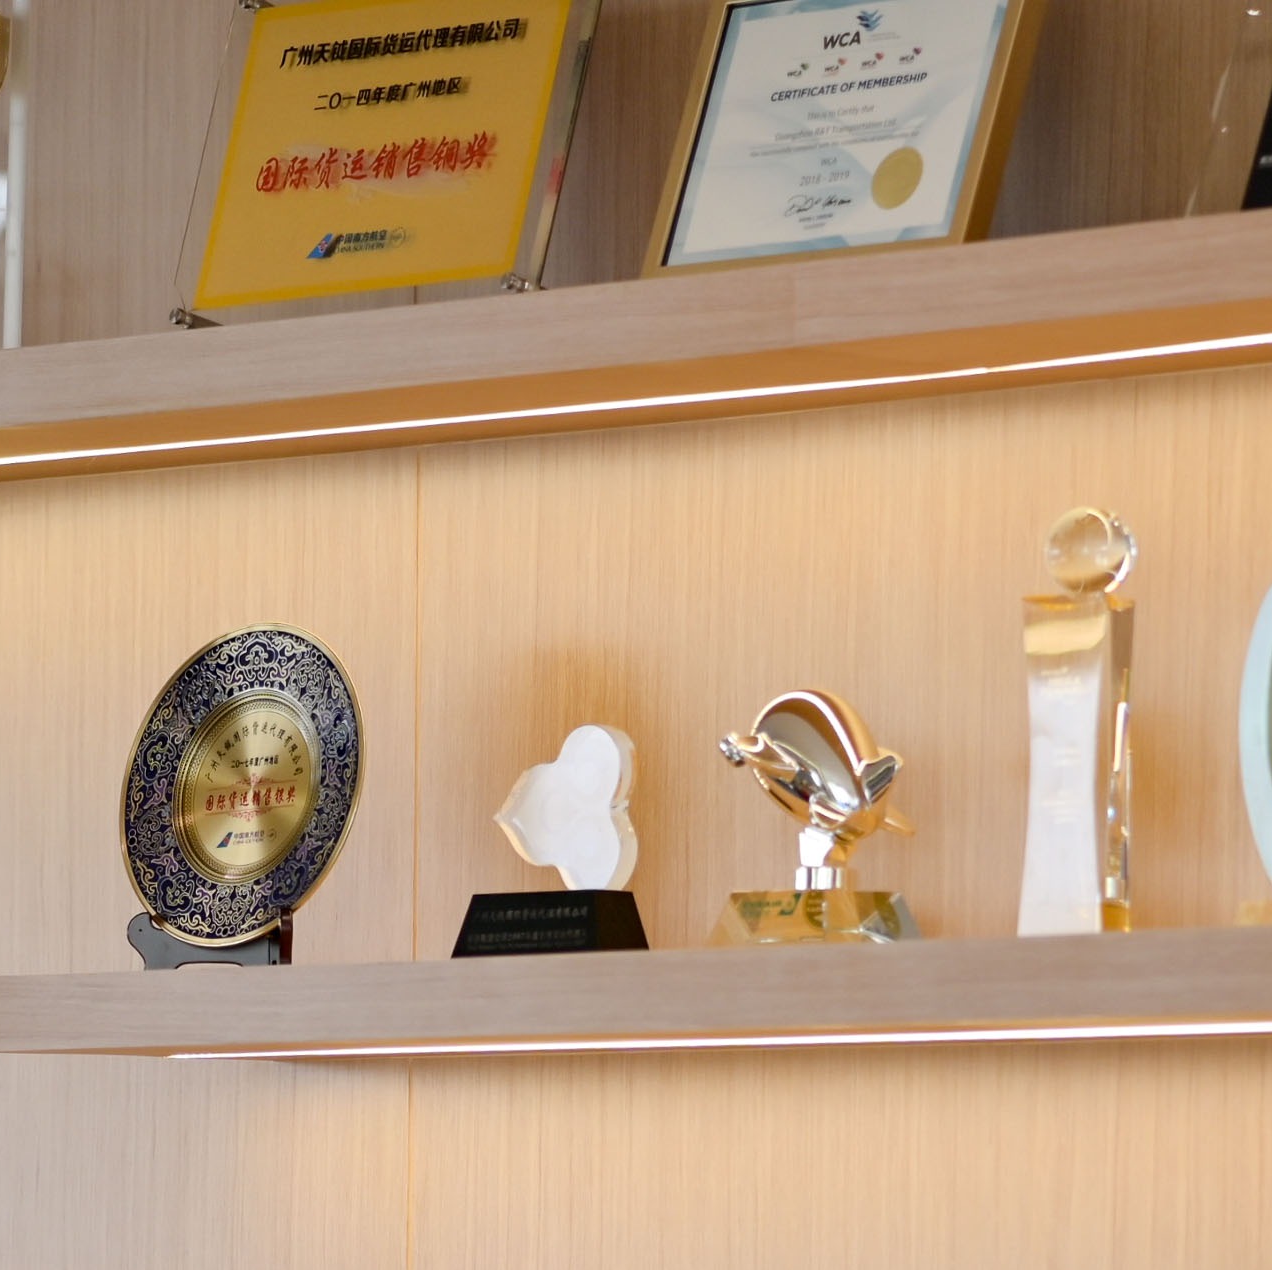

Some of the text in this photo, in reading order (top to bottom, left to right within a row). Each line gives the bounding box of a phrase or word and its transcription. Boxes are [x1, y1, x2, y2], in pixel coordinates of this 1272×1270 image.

[823, 30, 861, 50] WCA
[771, 72, 928, 102] CERTIFICATE OF MEMBERSHIP
